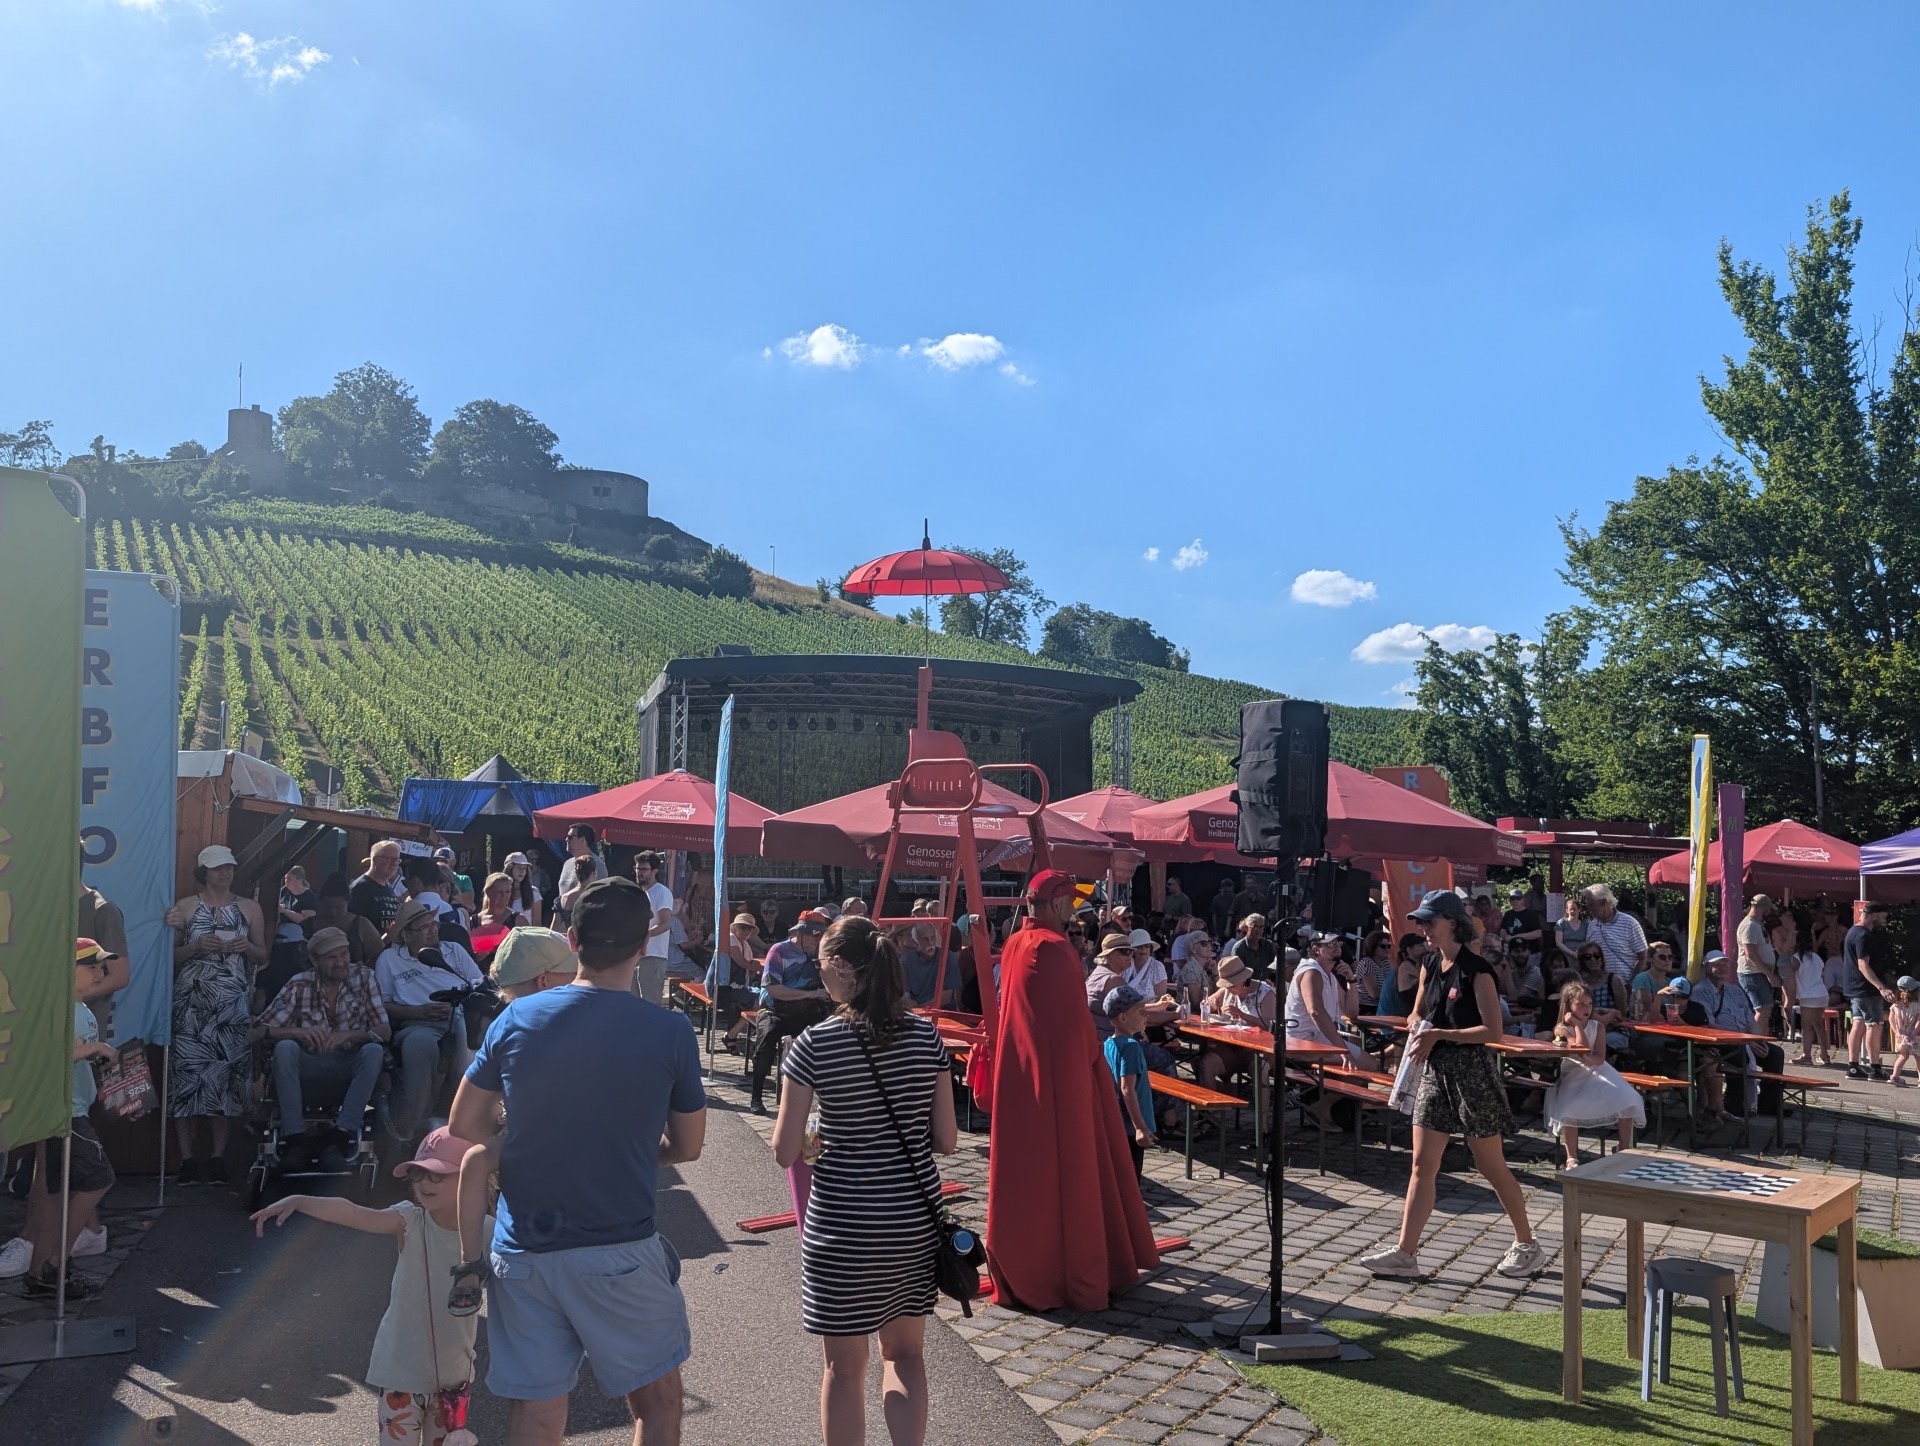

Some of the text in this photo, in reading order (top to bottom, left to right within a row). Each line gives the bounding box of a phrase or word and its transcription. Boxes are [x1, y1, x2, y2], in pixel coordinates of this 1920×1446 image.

[1208, 817, 1238, 829] Genos
[906, 858, 939, 869] Heilbronn
[128, 1082, 151, 1097] 1525
